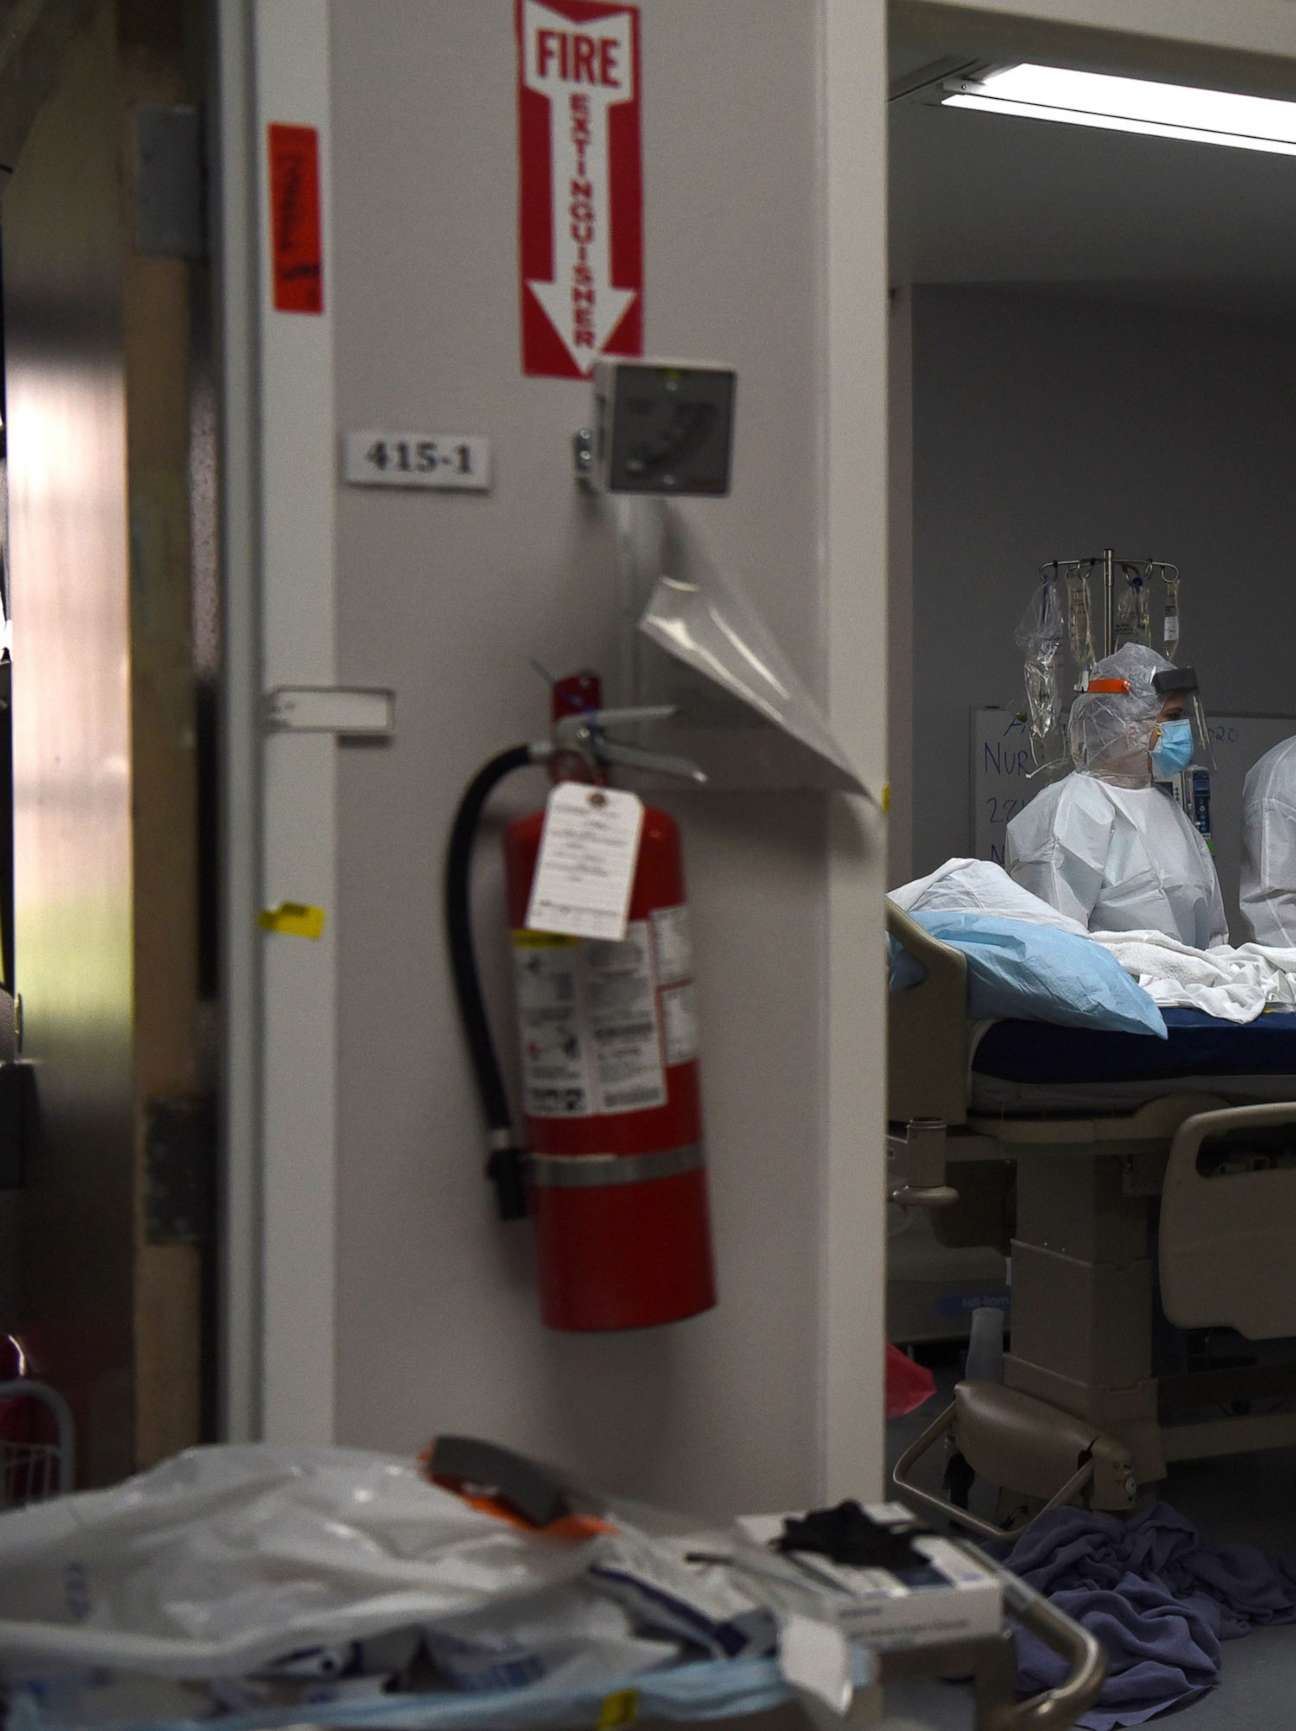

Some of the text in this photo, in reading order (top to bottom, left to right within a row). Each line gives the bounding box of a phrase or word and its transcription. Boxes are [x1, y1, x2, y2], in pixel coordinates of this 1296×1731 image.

[537, 30, 621, 87] FIRE
[569, 93, 595, 348] EXTINGUISHER
[365, 439, 474, 475] 415-1
[984, 741, 1031, 776] NUR
